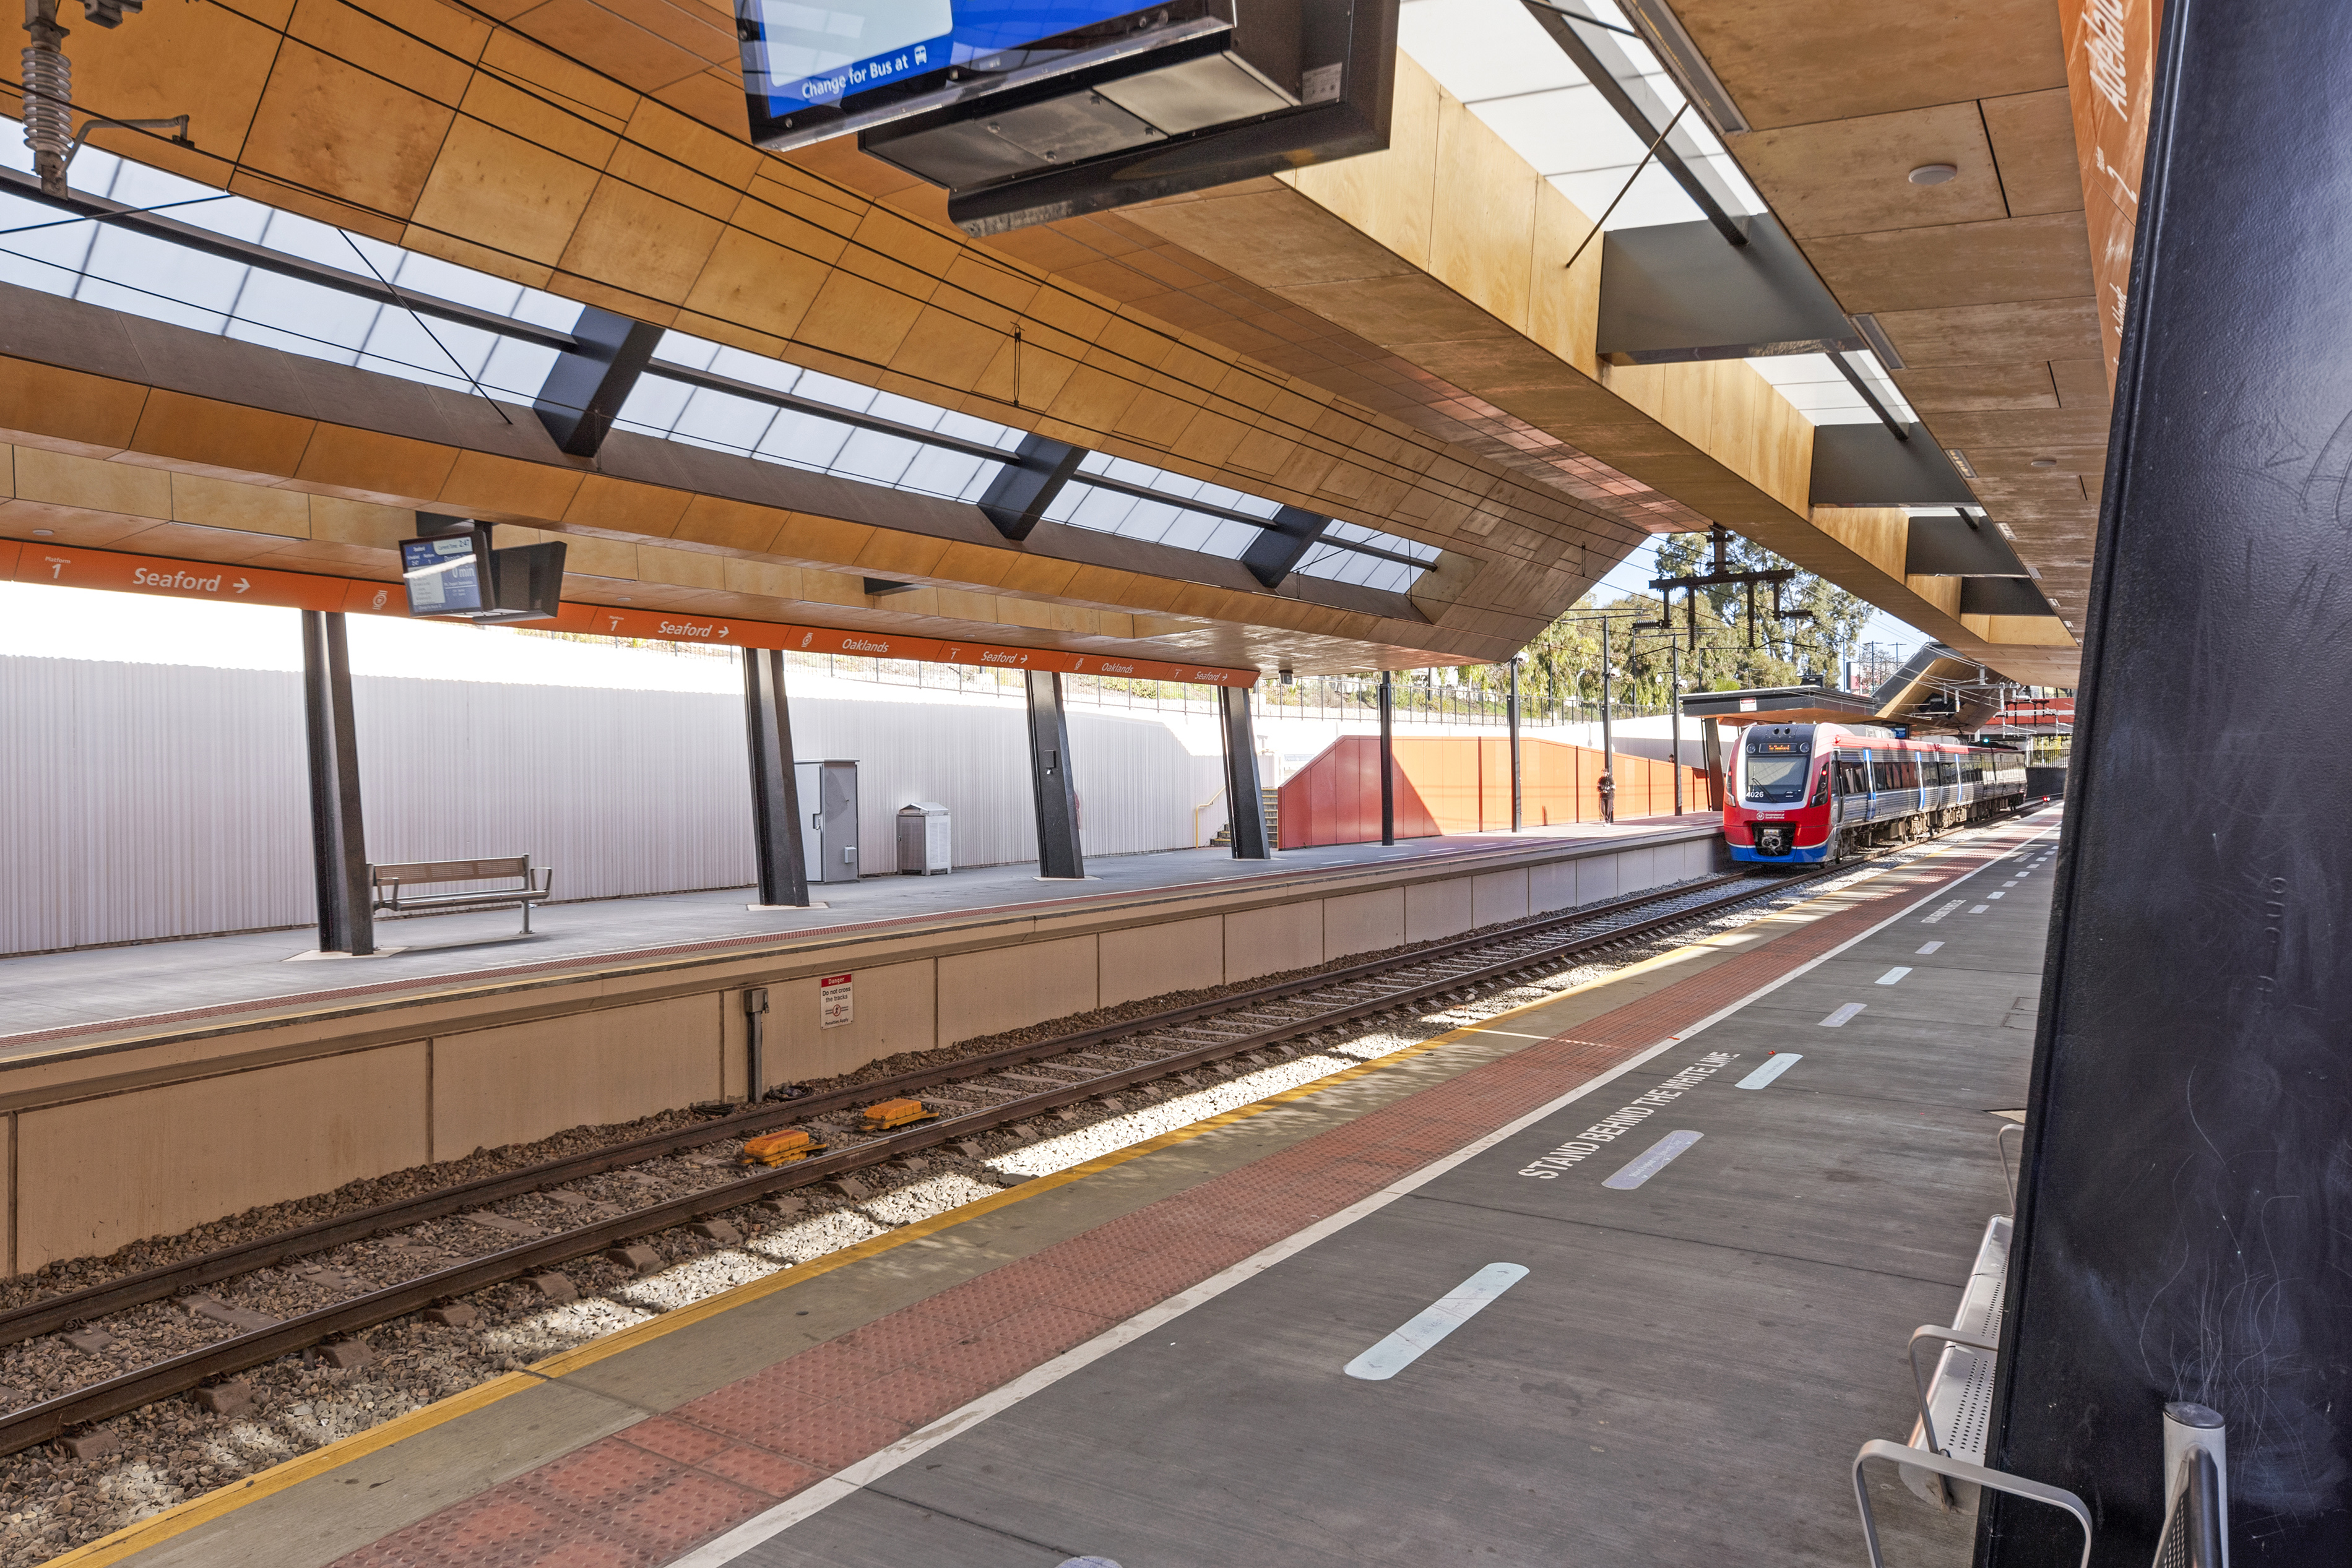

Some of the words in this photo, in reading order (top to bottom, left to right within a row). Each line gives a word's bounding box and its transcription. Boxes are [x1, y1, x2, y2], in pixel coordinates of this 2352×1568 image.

[802, 75, 847, 99] Change
[848, 66, 867, 85] for
[869, 61, 893, 79] Bus
[895, 54, 909, 71] at
[2106, 165, 2137, 204] 2
[52, 564, 61, 579] 1
[132, 567, 222, 592] Seaford
[610, 620, 618, 631] 1
[658, 621, 713, 637] Seaford
[842, 639, 889, 653] Oaklands
[951, 651, 956, 660] 1
[981, 651, 1018, 664] Seaford
[1101, 663, 1134, 674] Oaklands
[1195, 671, 1221, 681] Seaford
[1518, 1141, 1600, 1179] STAND
[1576, 1106, 1654, 1142] BEHIND
[1631, 1088, 1683, 1106] THE
[1657, 1066, 1718, 1090] WHITE
[1695, 1052, 1740, 1067] LINE
